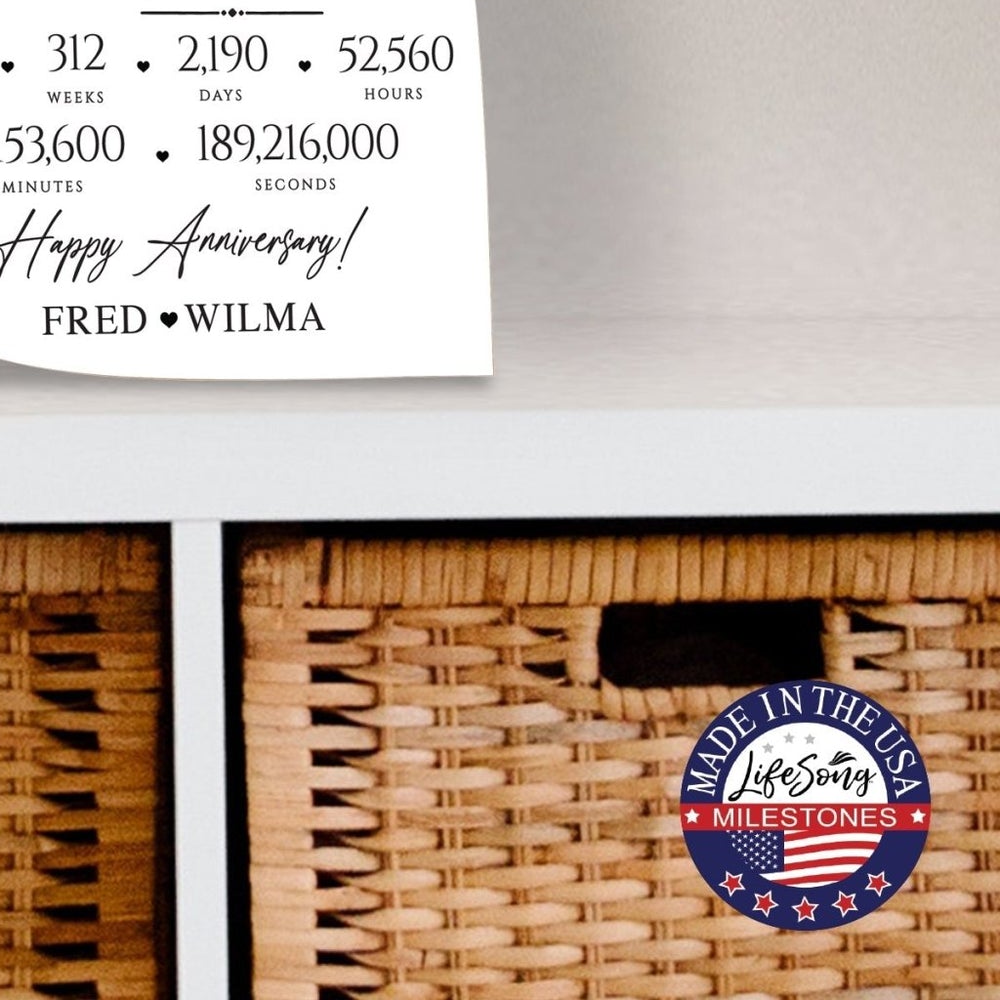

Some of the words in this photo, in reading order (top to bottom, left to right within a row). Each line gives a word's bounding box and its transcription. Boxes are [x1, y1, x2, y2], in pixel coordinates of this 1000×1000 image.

[46, 33, 107, 73] 312
[177, 34, 269, 76] 2,190
[337, 34, 455, 75] 52,560
[46, 90, 105, 105] WEEKS
[199, 88, 243, 103] DAYS
[364, 87, 424, 101] HOURS
[197, 122, 400, 165] 189,216,000
[1, 180, 84, 194] MINUTES
[254, 177, 337, 192] SECONDS
[132, 203, 370, 281] Anniversary!
[42, 304, 148, 336] FRED
[185, 302, 326, 334] WILMA
